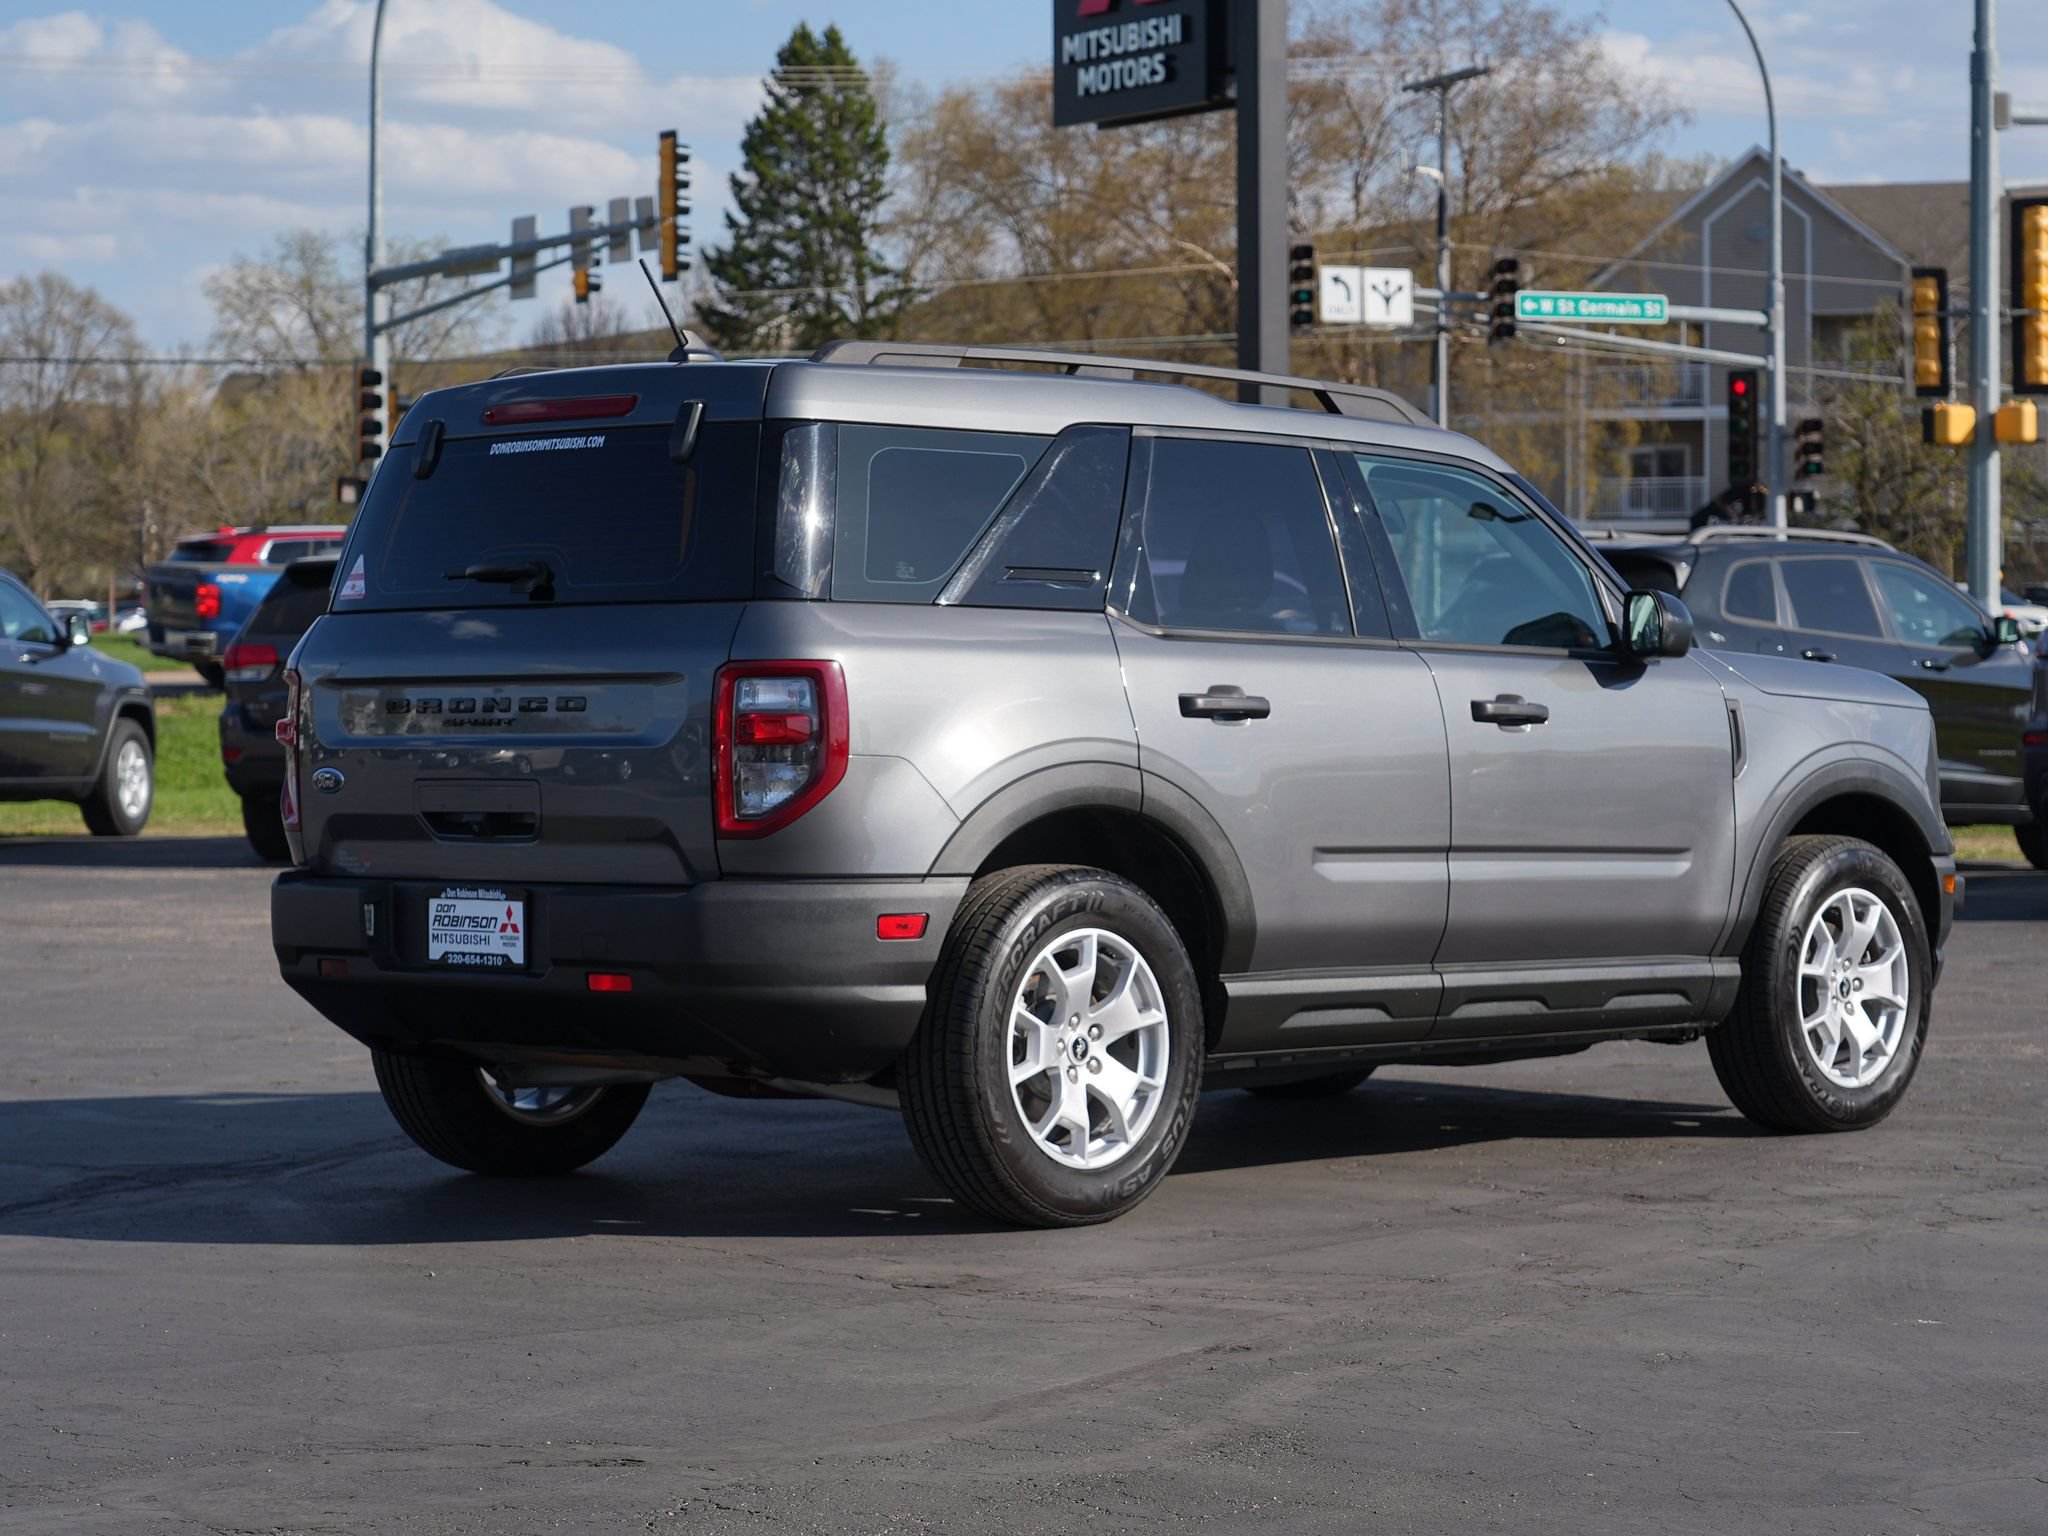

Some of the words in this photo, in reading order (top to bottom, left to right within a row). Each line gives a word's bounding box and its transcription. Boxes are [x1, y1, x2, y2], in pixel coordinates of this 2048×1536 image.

[1062, 14, 1182, 64] MITSUBISHI
[1077, 52, 1166, 97] MOTORS
[1540, 298, 1554, 314] W
[1557, 298, 1576, 315] St
[1578, 299, 1642, 316] Germain
[1644, 301, 1662, 317] St
[489, 435, 605, 455] DONROBINSONMITSUBISHI.COM
[385, 696, 587, 714] BRONCO
[432, 915, 498, 929] ROBINSON
[432, 933, 490, 946] MITSUBISHI
[447, 954, 502, 966] 320-654-1310
